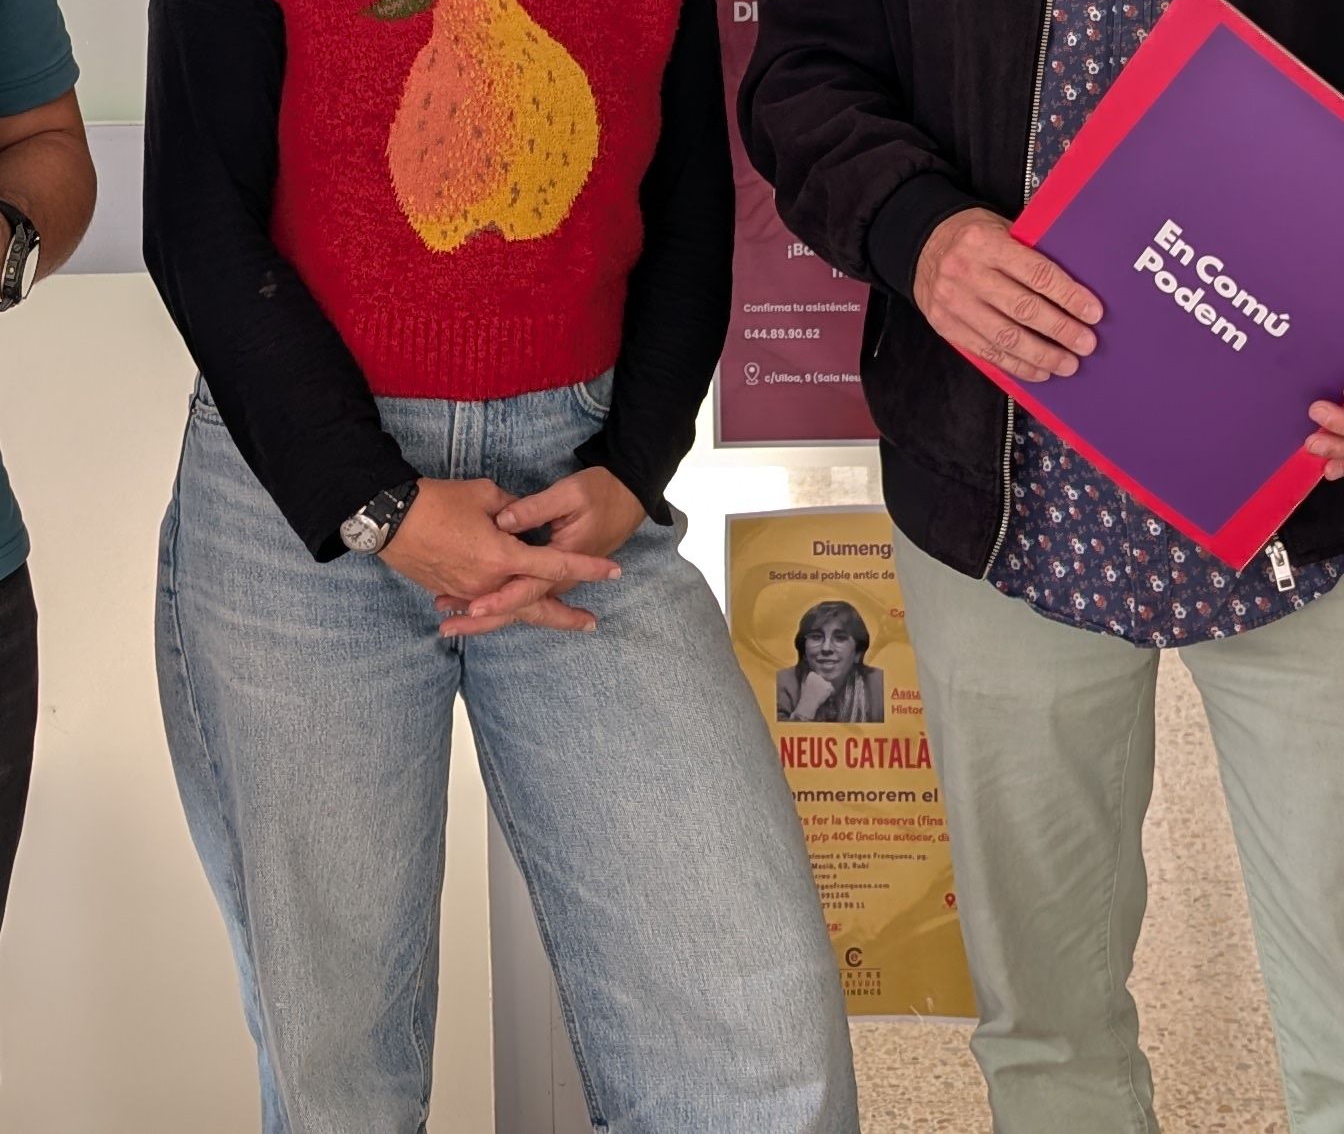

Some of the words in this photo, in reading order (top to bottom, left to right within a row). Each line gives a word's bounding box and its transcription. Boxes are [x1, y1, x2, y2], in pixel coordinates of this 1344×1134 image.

[1154, 218, 1195, 267] En
[1196, 255, 1290, 337] Comú
[1133, 246, 1248, 352] Podem
[744, 303, 791, 313] Confirma
[794, 304, 804, 312] tu
[744, 328, 820, 339] 644.89.90.62
[842, 374, 861, 383] Neu
[812, 540, 893, 560] Diumeng
[769, 570, 808, 581] Sortida
[810, 570, 819, 580] al
[821, 570, 850, 582] poble
[852, 570, 879, 580] antic
[892, 705, 924, 715] Histor
[780, 736, 837, 769] NEUS
[845, 732, 932, 769] CATALÀ
[922, 788, 938, 802] el
[812, 815, 828, 826] fer
[832, 815, 842, 826] la
[844, 816, 869, 826] teva
[872, 817, 915, 826] reserva
[832, 832, 854, 841] 40€
